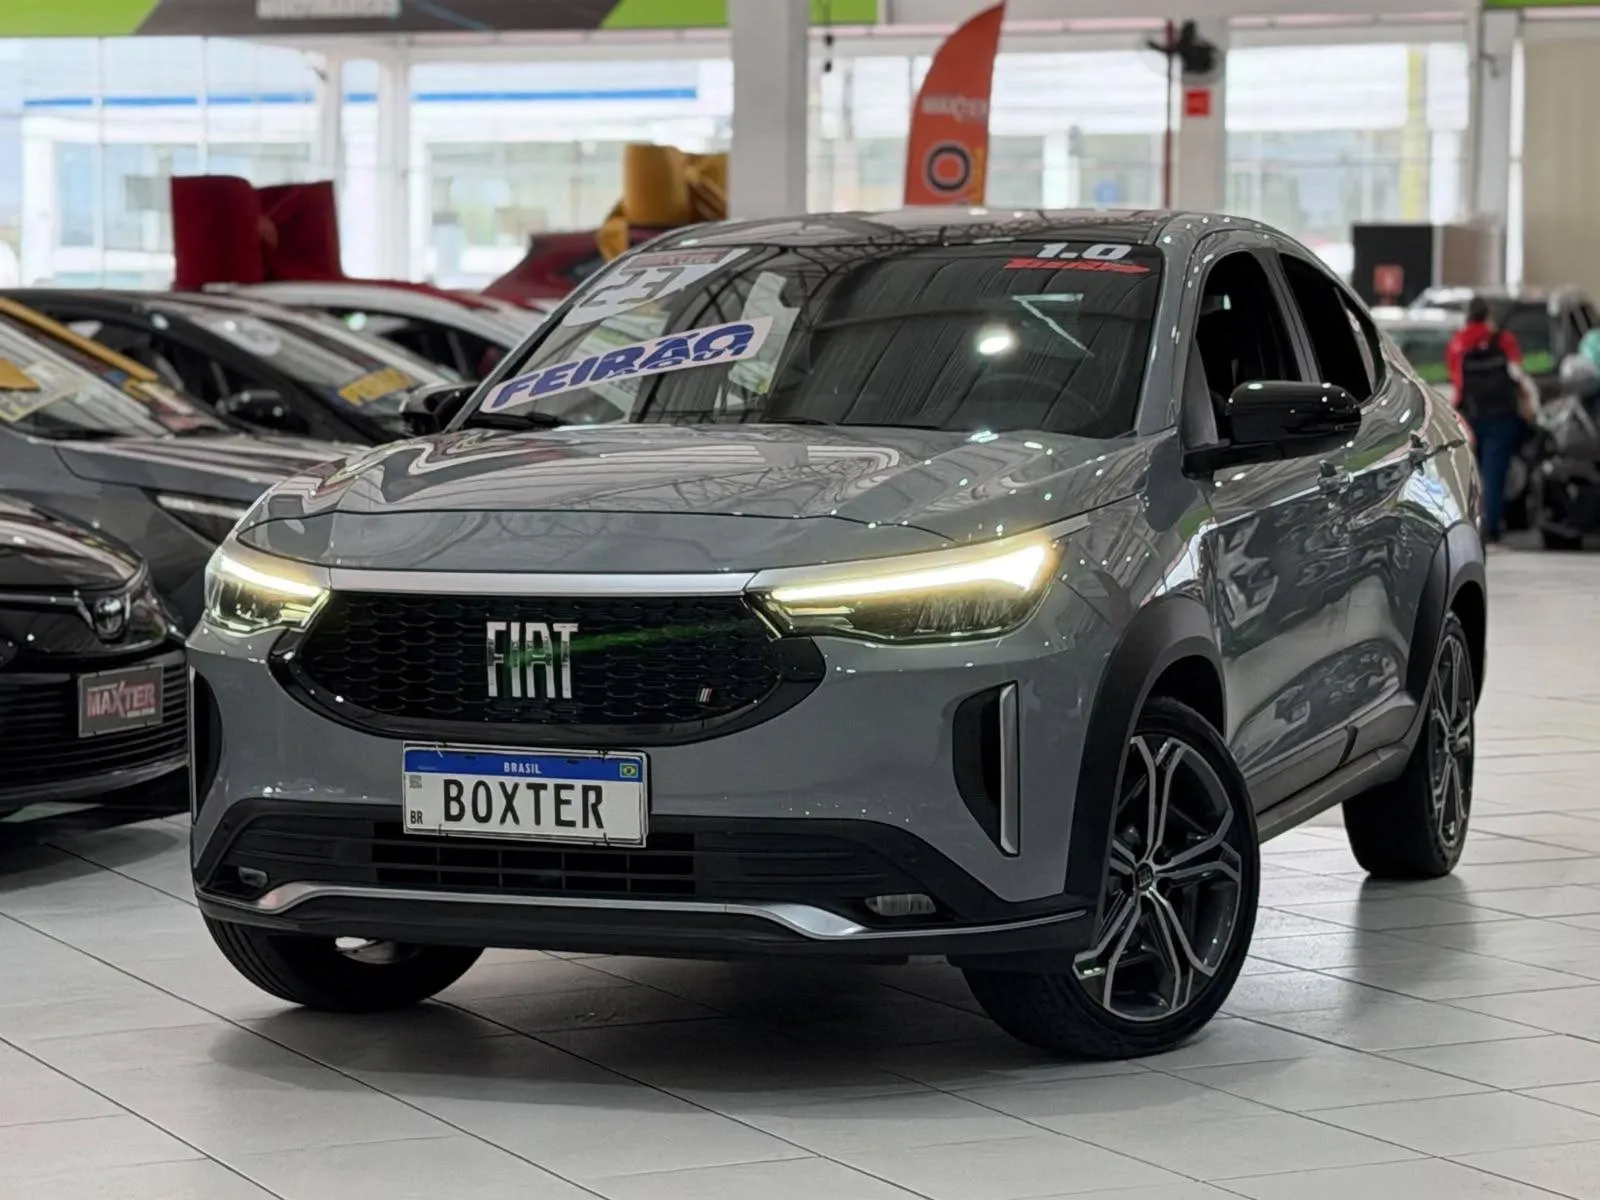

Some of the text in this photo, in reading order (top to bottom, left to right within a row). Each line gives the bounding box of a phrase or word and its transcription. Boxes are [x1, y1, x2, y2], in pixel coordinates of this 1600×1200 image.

[1036, 242, 1132, 260] 1.0
[486, 621, 579, 699] FIAT
[86, 681, 156, 718] MAXTER
[503, 761, 542, 774] BRASIL
[410, 809, 424, 825] BR
[443, 778, 605, 829] BOXTER
